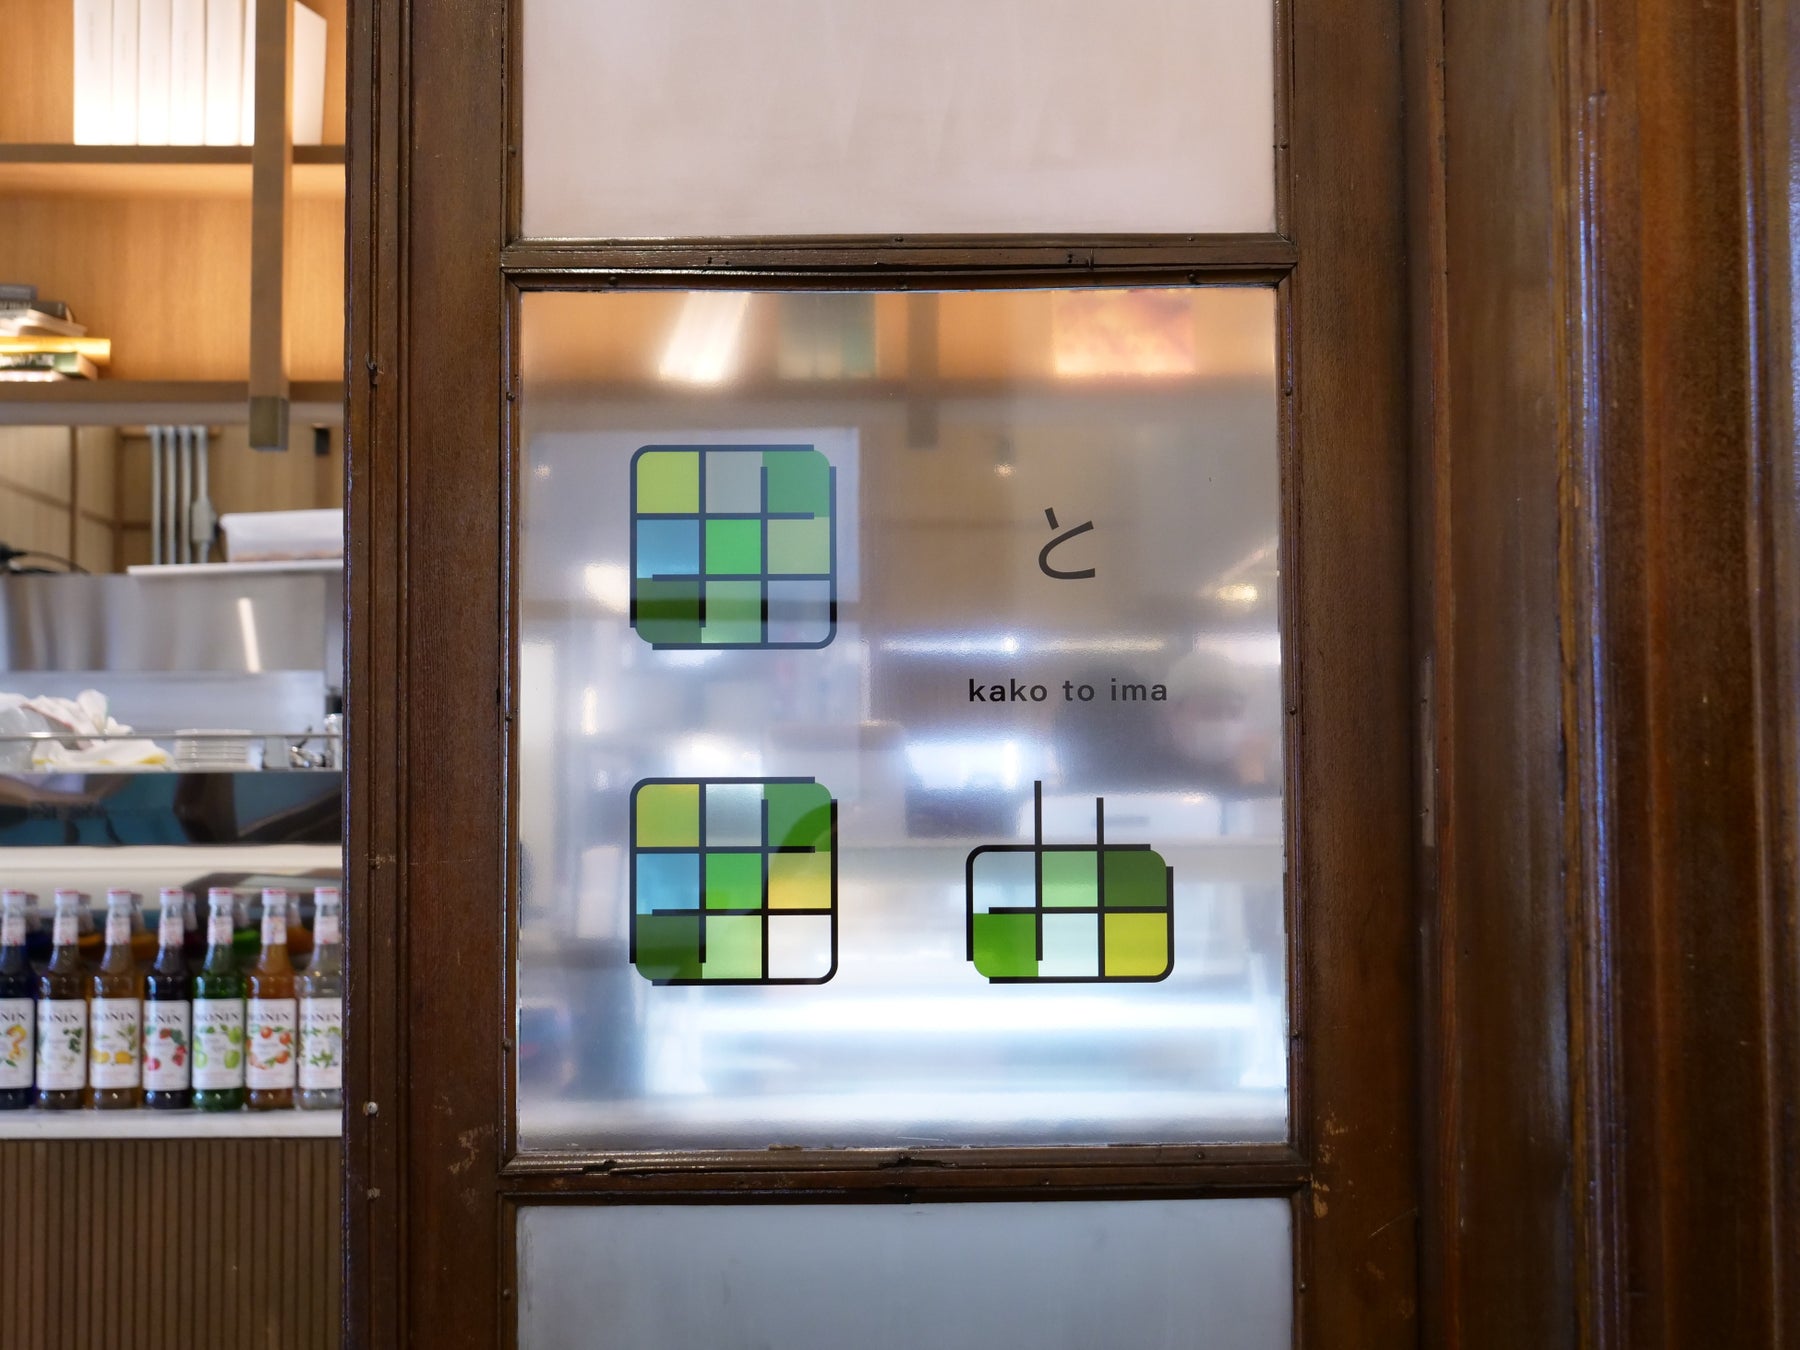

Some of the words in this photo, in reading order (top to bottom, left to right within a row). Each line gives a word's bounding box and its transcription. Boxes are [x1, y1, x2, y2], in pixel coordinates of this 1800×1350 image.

[1038, 507, 1096, 580] と
[968, 678, 1048, 702] kako
[1062, 680, 1096, 702] to
[1110, 678, 1168, 702] ima
